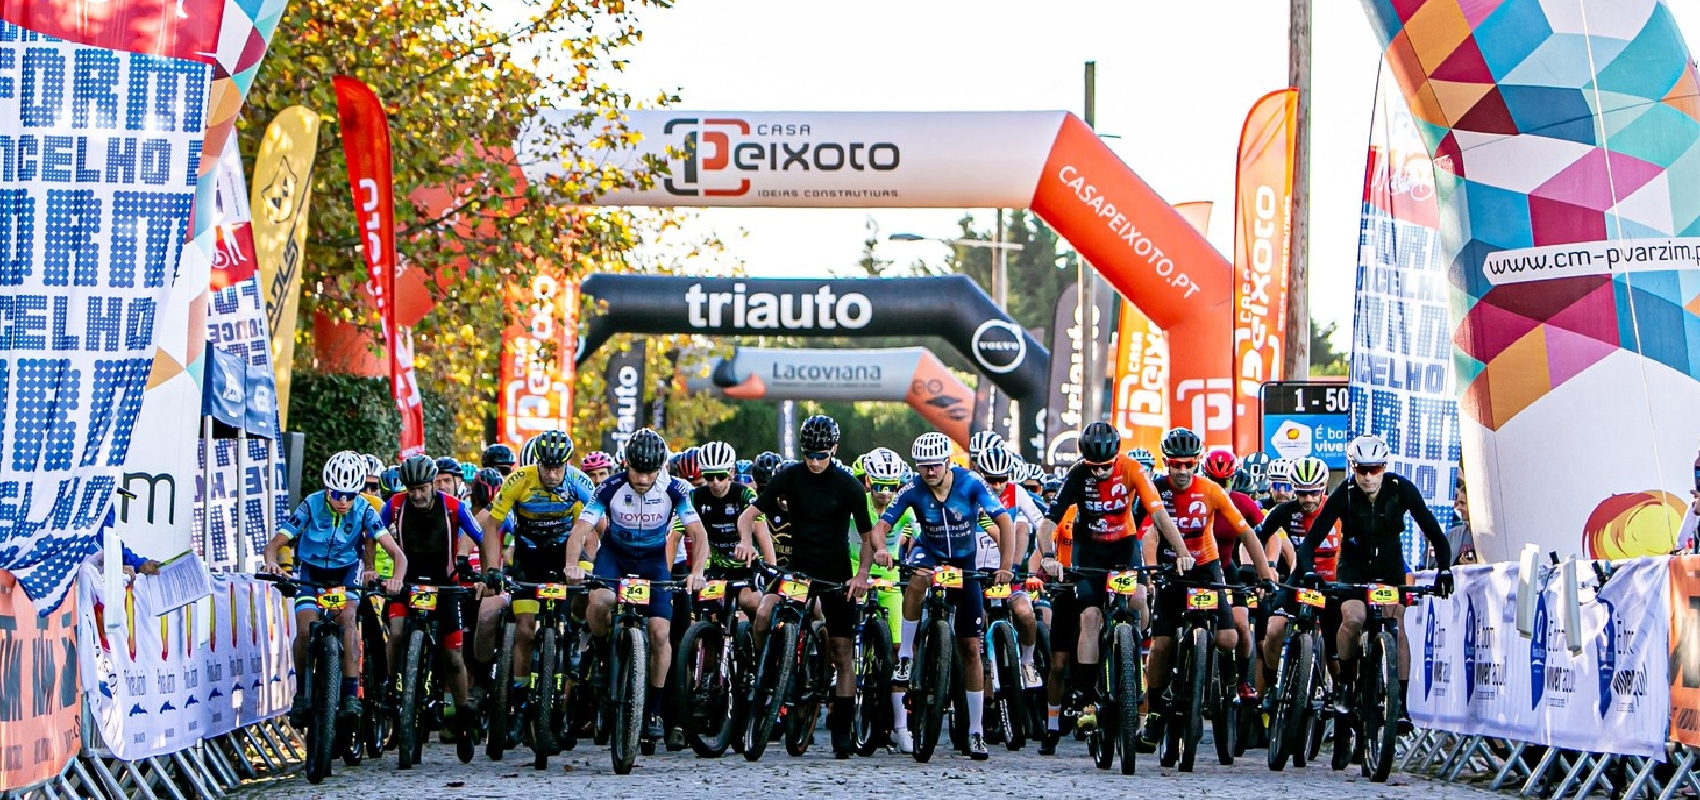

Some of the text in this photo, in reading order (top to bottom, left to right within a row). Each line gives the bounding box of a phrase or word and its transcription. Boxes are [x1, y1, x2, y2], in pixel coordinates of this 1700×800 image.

[757, 124, 811, 136] CASA
[1059, 165, 1200, 298] CASAPEIXOTO.PT
[685, 282, 873, 329] triauto
[772, 361, 882, 381] Lacoviana
[1294, 388, 1306, 411] 1
[1315, 424, 1347, 439] É bo
[620, 512, 663, 523] TOYOTA
